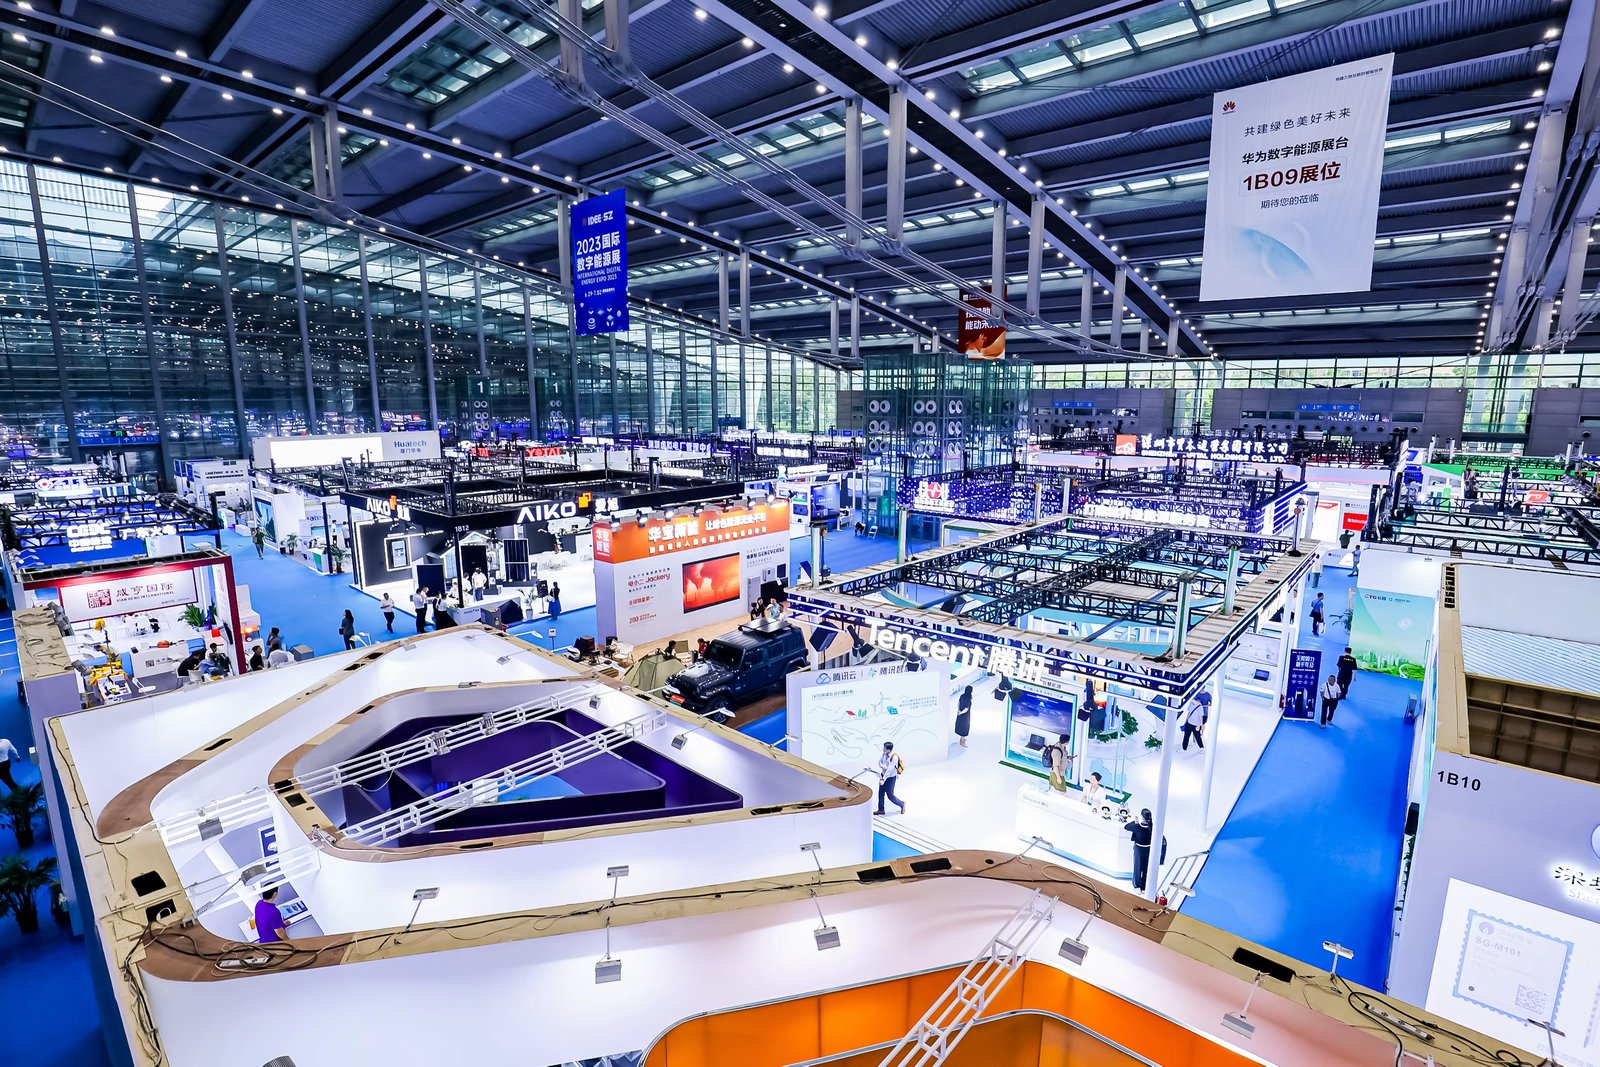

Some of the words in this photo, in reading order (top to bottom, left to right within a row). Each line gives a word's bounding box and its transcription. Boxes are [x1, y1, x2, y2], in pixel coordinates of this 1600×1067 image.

[1244, 107, 1351, 137] 共建绿色美好未来
[1242, 136, 1349, 164] 华为数字能源展台
[1243, 161, 1341, 191] 1B09展位
[1260, 193, 1319, 210] 期待您的莅临
[576, 231, 620, 255] 2023国际
[576, 249, 621, 272] 数字能源展
[477, 381, 484, 394] 1
[553, 382, 559, 394] 1
[394, 440, 427, 448] Huatech
[1182, 452, 1208, 460] APITAL
[1210, 453, 1249, 461] HOLDINGS
[366, 497, 391, 517] AIKO
[517, 502, 577, 523] AIKO
[648, 520, 699, 542] 华宝新能
[646, 573, 671, 583] Jackery
[115, 582, 174, 598] 咸亨国际
[864, 618, 983, 669] Tencent
[987, 645, 1047, 683] 腾讯
[833, 671, 857, 682] 腾讯云
[880, 664, 908, 676] 腾讯智
[1436, 770, 1482, 792] 1B10
[1474, 936, 1522, 958] SG-M101
